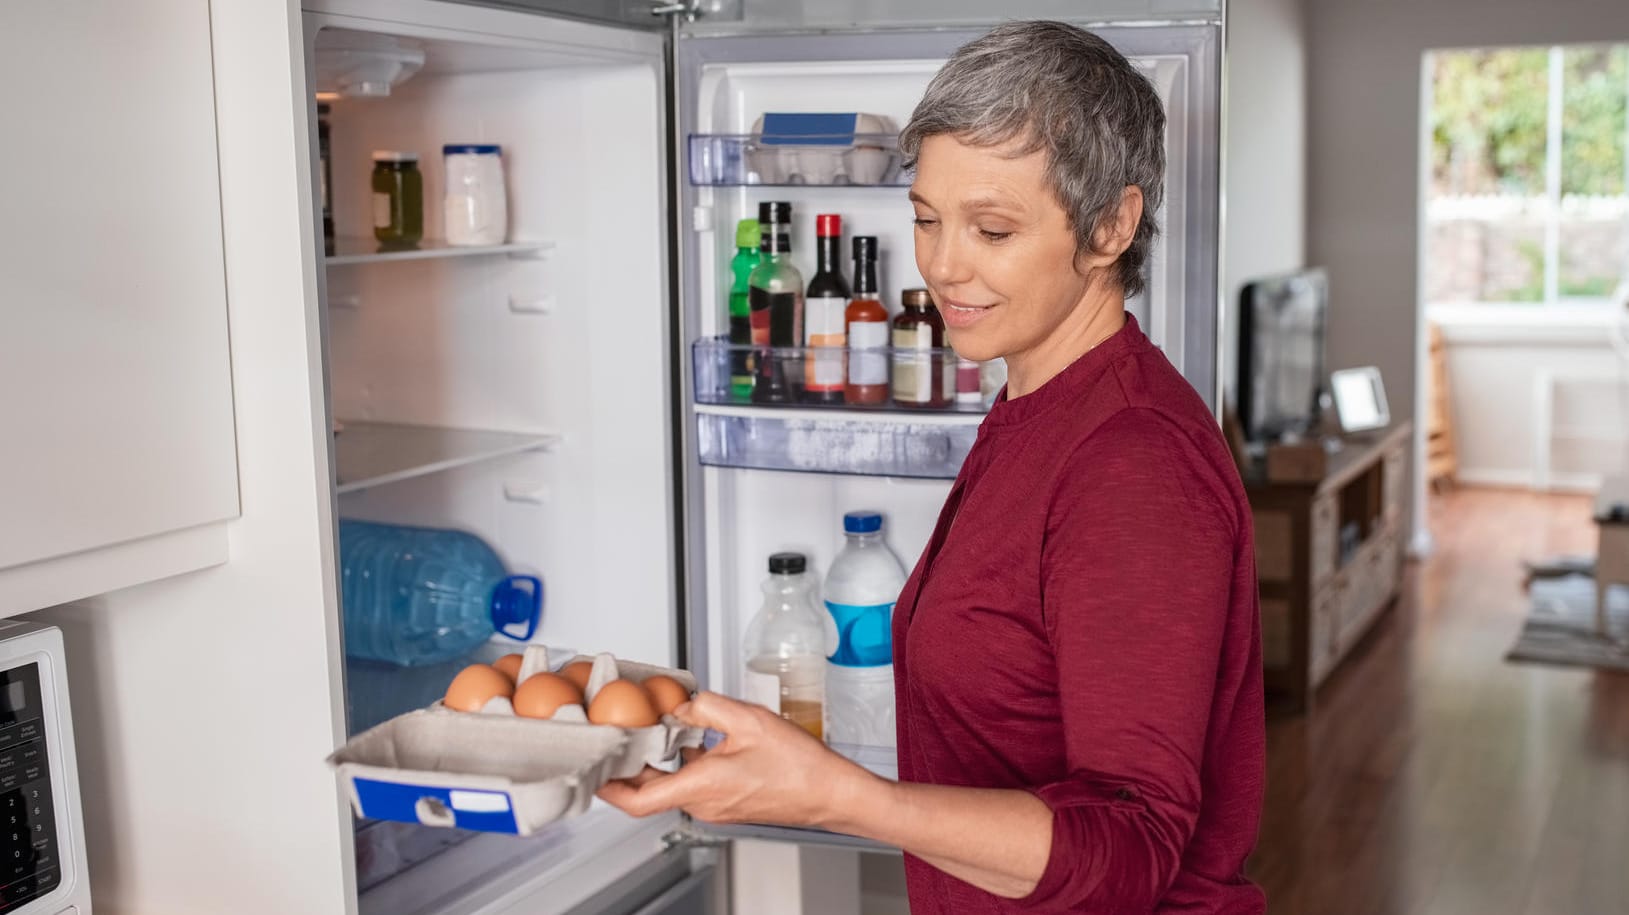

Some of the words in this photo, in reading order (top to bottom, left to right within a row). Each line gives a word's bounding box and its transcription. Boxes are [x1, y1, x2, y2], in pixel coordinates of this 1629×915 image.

[33, 790, 39, 798] 3
[9, 799, 14, 807] 2
[34, 807, 40, 815] 6
[11, 816, 16, 824] 5
[13, 833, 18, 841] 8
[14, 850, 20, 858] 0
